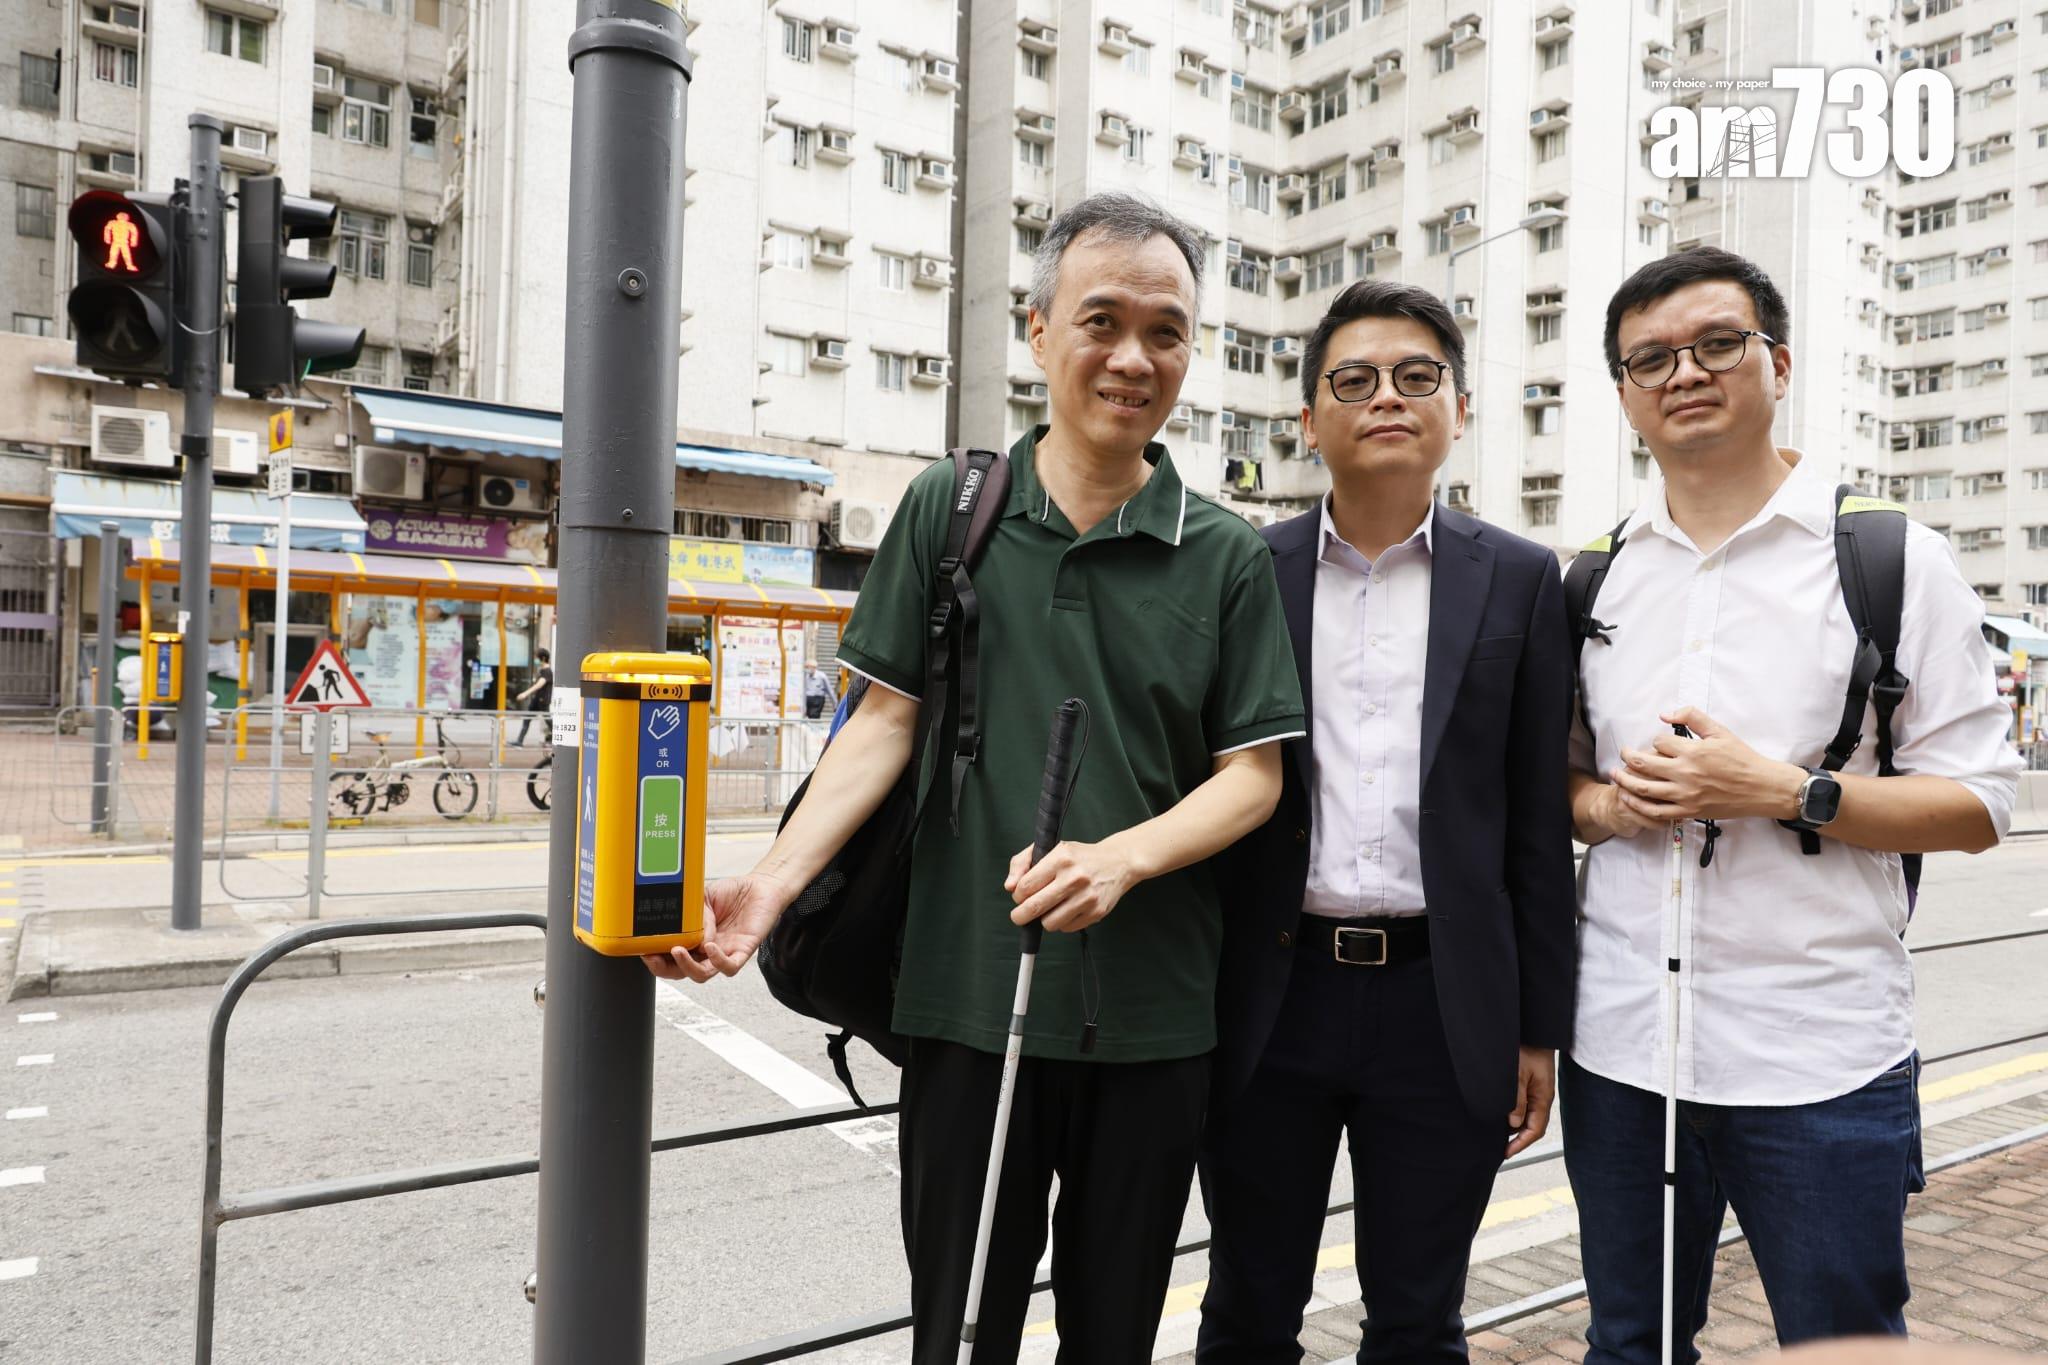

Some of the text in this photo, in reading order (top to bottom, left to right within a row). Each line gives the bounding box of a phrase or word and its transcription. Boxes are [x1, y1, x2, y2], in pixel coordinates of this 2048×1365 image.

[957, 469, 980, 511] NIKKO
[658, 747, 668, 757] 或
[656, 760, 670, 768] OR
[654, 813, 668, 827] 按
[645, 830, 676, 838] PRESS
